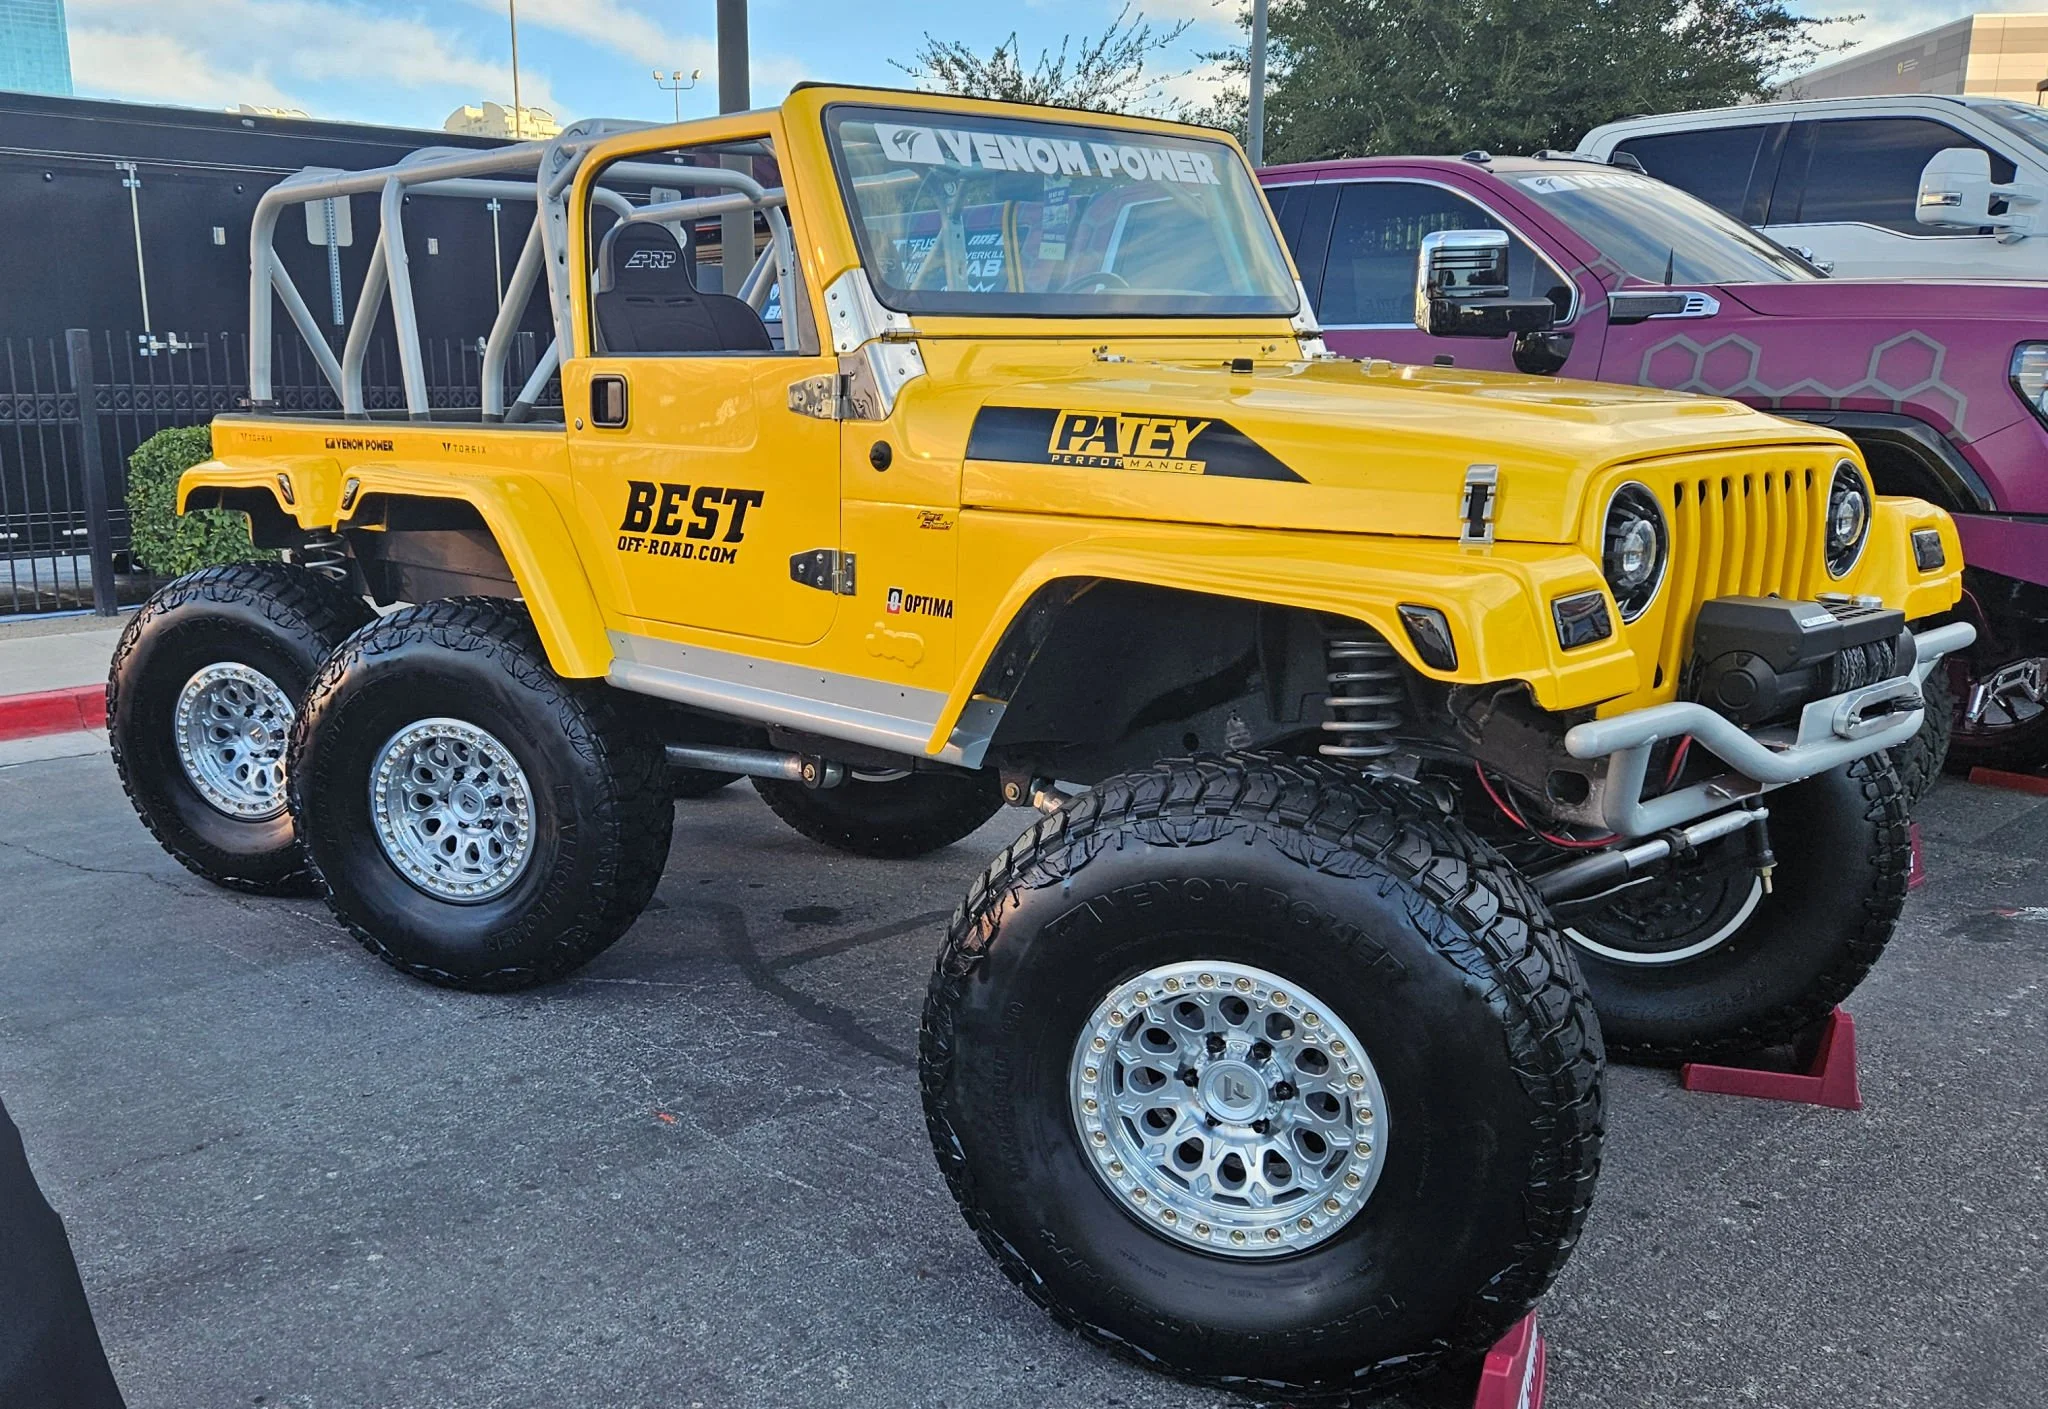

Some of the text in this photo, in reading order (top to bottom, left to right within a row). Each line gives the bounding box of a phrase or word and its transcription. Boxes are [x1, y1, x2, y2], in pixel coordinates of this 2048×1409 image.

[939, 130, 1222, 185] VENOM POWER
[625, 251, 677, 268] PRP
[966, 251, 1004, 260] VERKILL
[336, 438, 394, 452] VENOM POWER
[1049, 410, 1211, 458] PATEY
[1051, 455, 1207, 475] PERFORMANCE
[619, 480, 765, 543] BEST
[617, 536, 738, 564] OFF-ROAD.COM
[904, 593, 954, 618] OPTIMA
